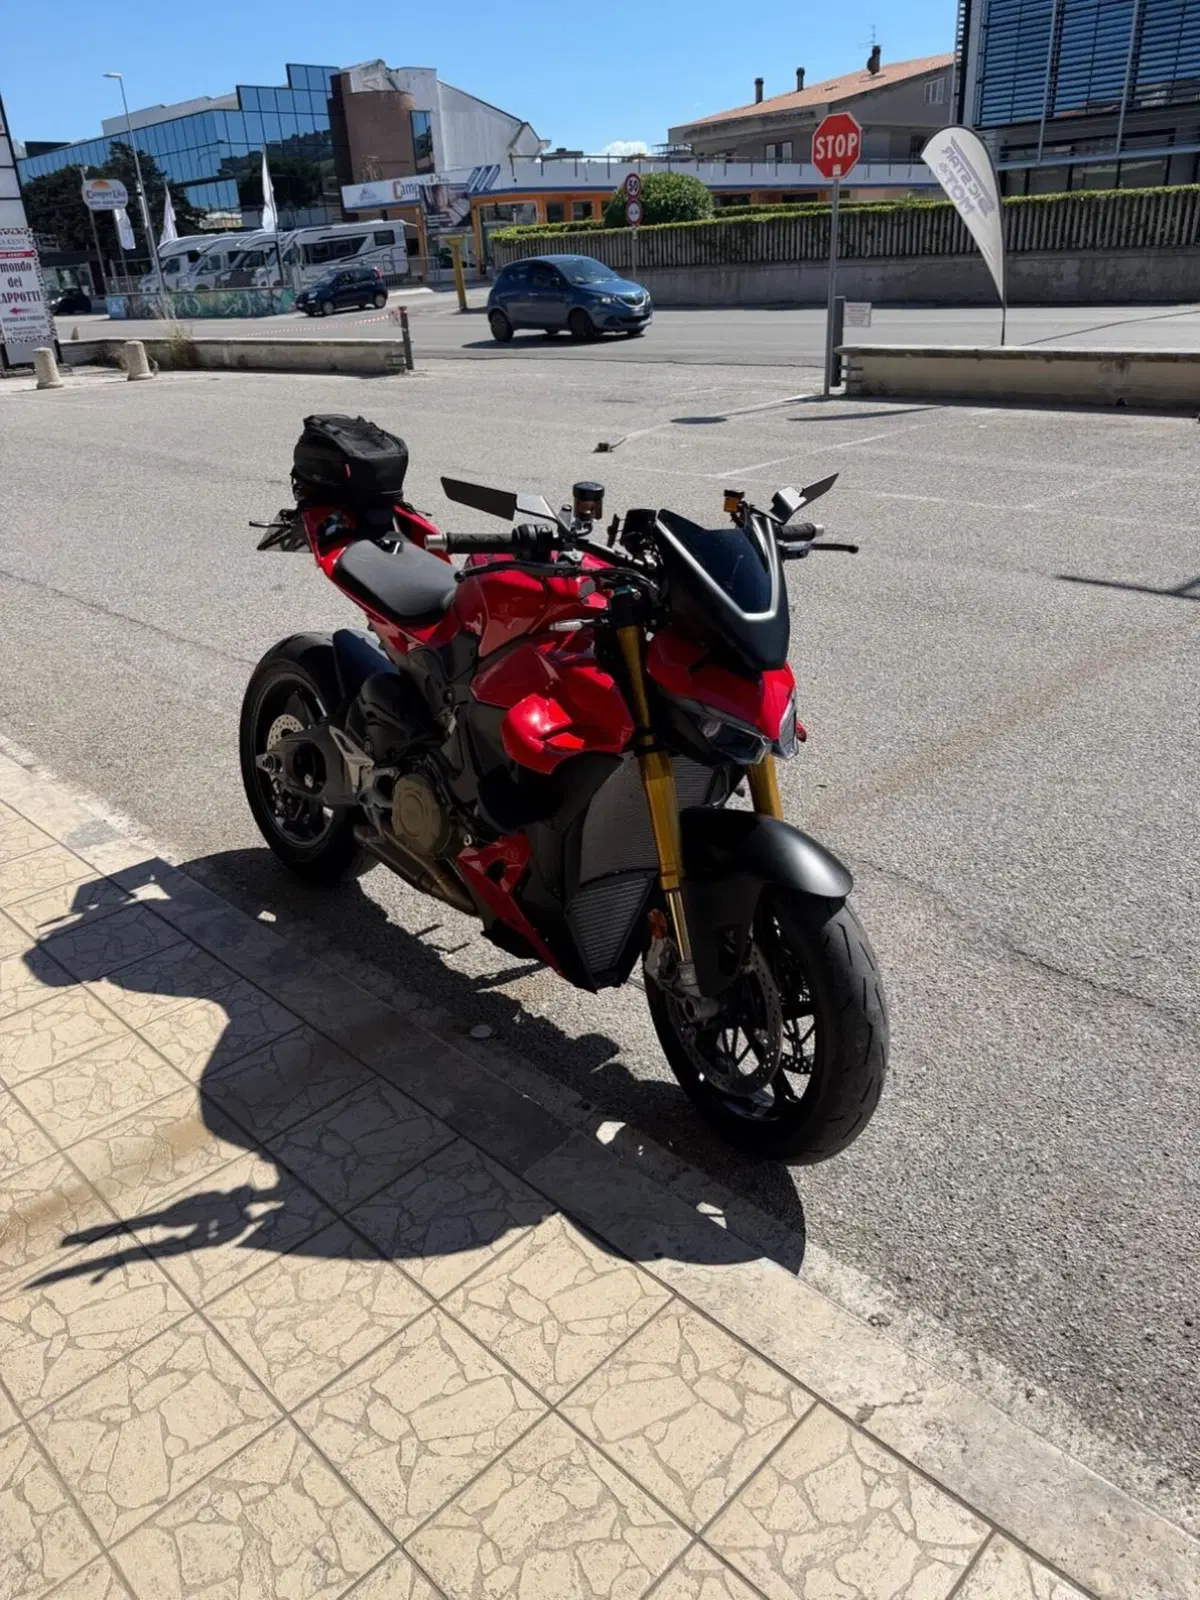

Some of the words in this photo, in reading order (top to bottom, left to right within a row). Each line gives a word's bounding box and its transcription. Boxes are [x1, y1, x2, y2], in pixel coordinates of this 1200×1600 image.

[815, 133, 858, 160] STOP
[393, 181, 420, 200] Camp
[629, 179, 639, 192] 50
[0, 261, 32, 272] mondo
[7, 276, 23, 288] dei
[0, 291, 41, 303] APPOTTI
